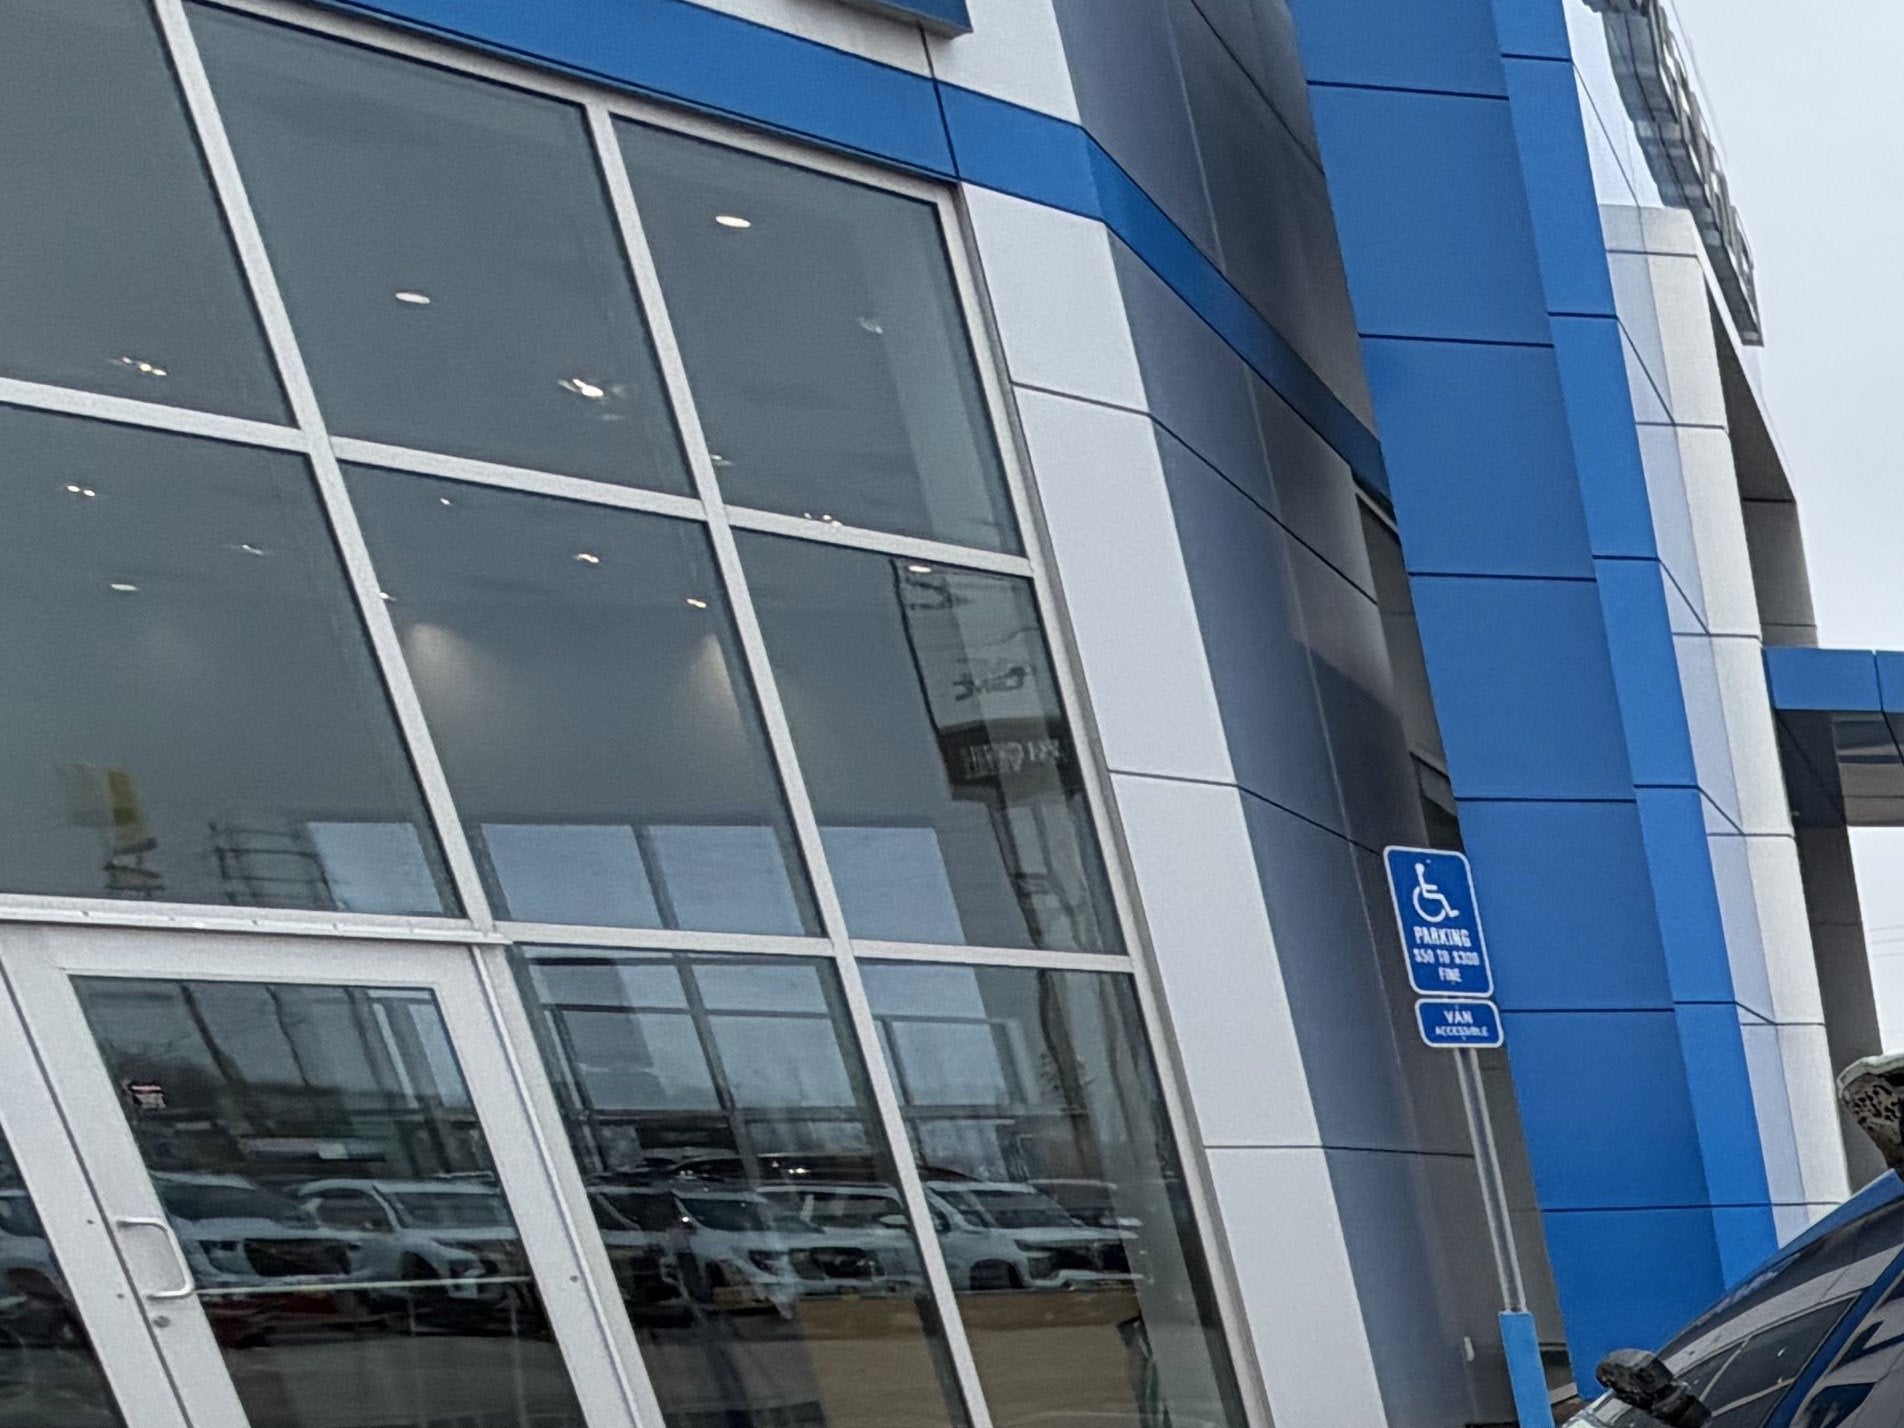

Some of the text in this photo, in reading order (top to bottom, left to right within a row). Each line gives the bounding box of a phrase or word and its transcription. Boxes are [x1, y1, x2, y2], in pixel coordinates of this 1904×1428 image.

[1413, 926, 1472, 948] PARKING
[1413, 948, 1435, 964] $50
[1436, 949, 1451, 964] TO
[1438, 966, 1462, 983] FINE
[1443, 1010, 1474, 1024] VAN
[1434, 1025, 1489, 1038] ACCESSIBLE
